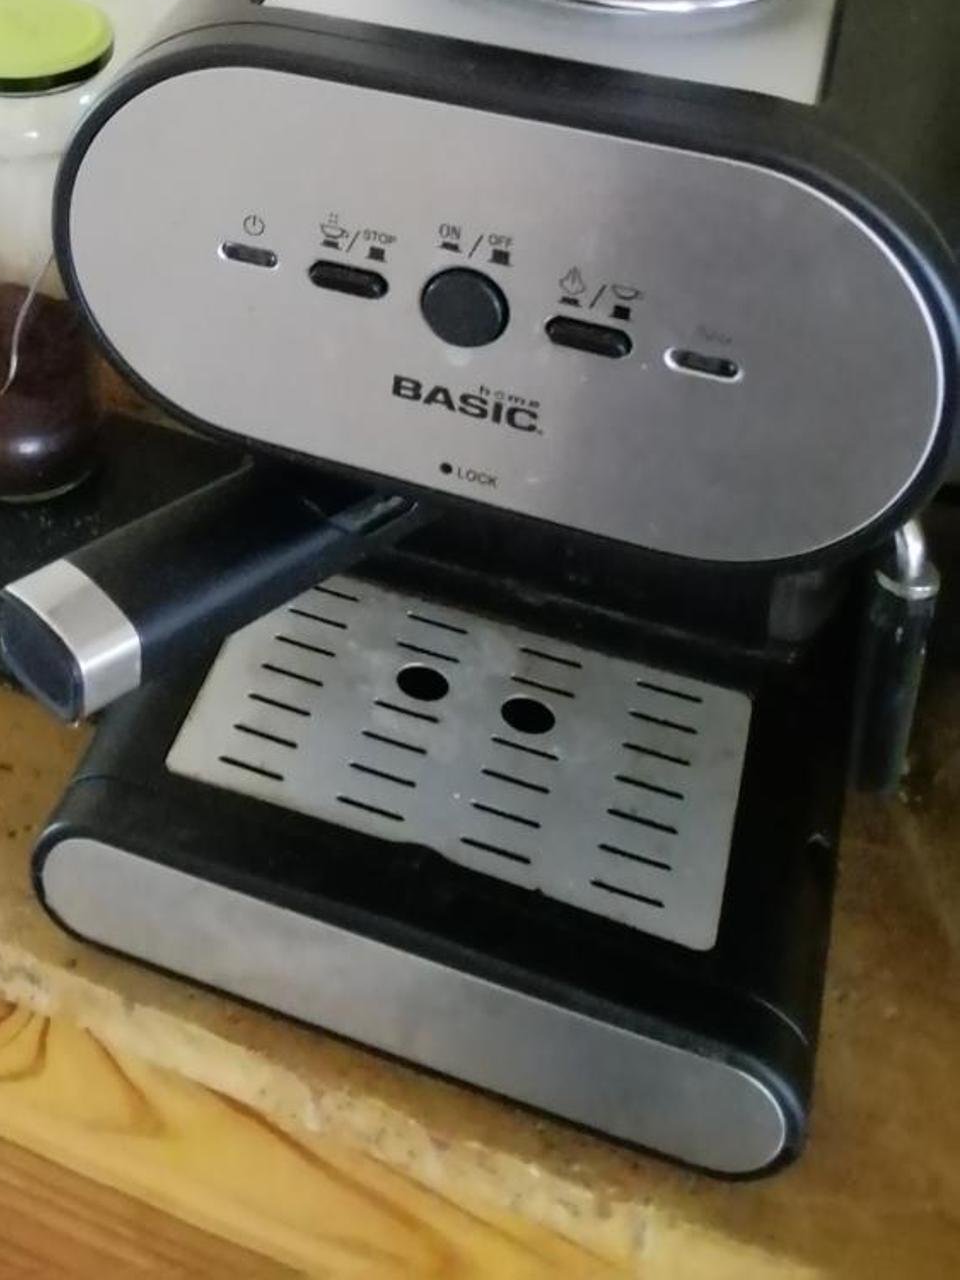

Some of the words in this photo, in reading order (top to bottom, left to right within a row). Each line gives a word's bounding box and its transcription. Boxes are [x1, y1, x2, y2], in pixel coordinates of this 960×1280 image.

[362, 228, 397, 245] STOP
[439, 223, 461, 240] ON
[488, 233, 513, 248] OFF
[392, 373, 539, 433] BASIC
[479, 384, 541, 409] home
[456, 467, 498, 489] LOCK
